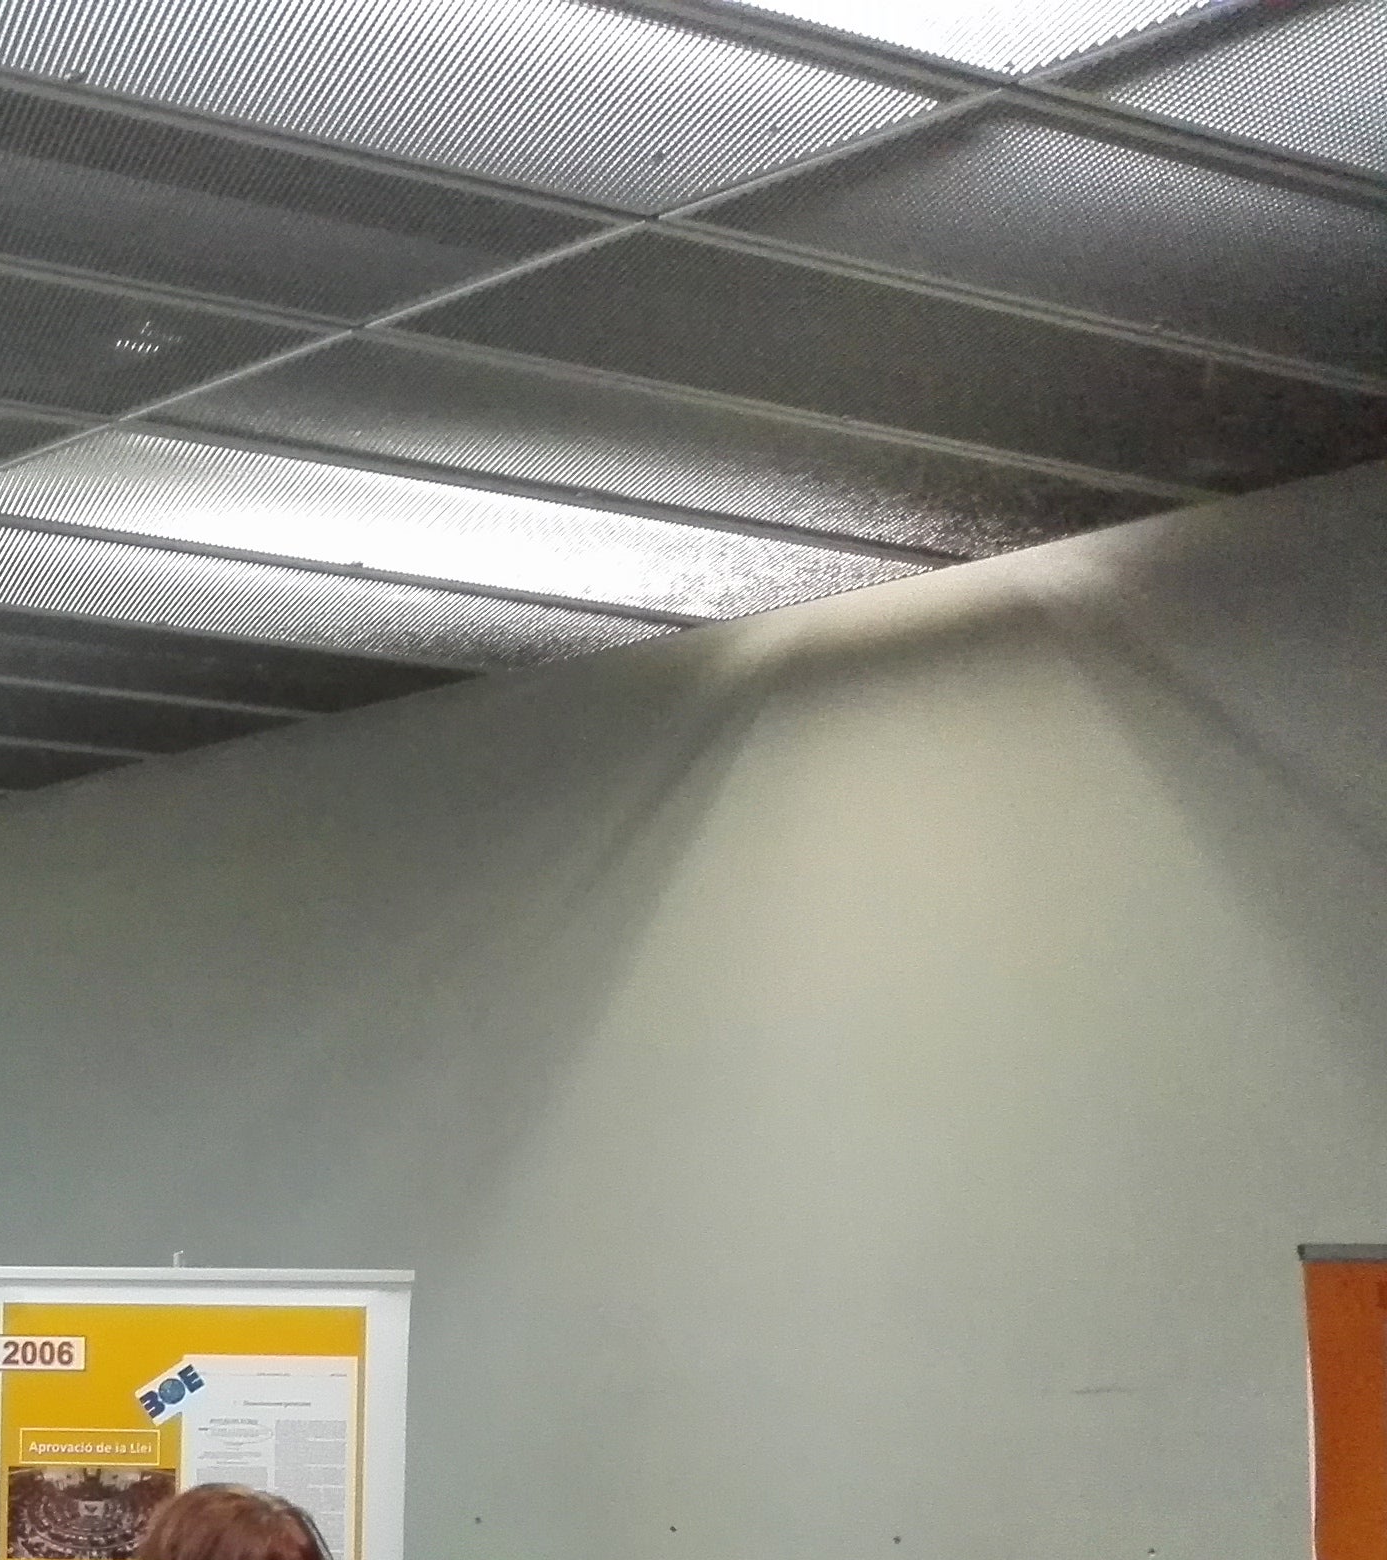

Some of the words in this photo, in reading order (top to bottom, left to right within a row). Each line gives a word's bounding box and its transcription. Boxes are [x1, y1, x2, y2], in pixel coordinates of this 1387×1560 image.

[2, 1341, 74, 1365] 2006
[28, 1441, 93, 1455] Aprovació
[96, 1442, 112, 1454] de
[115, 1443, 127, 1454] la
[130, 1443, 152, 1454] Llei
